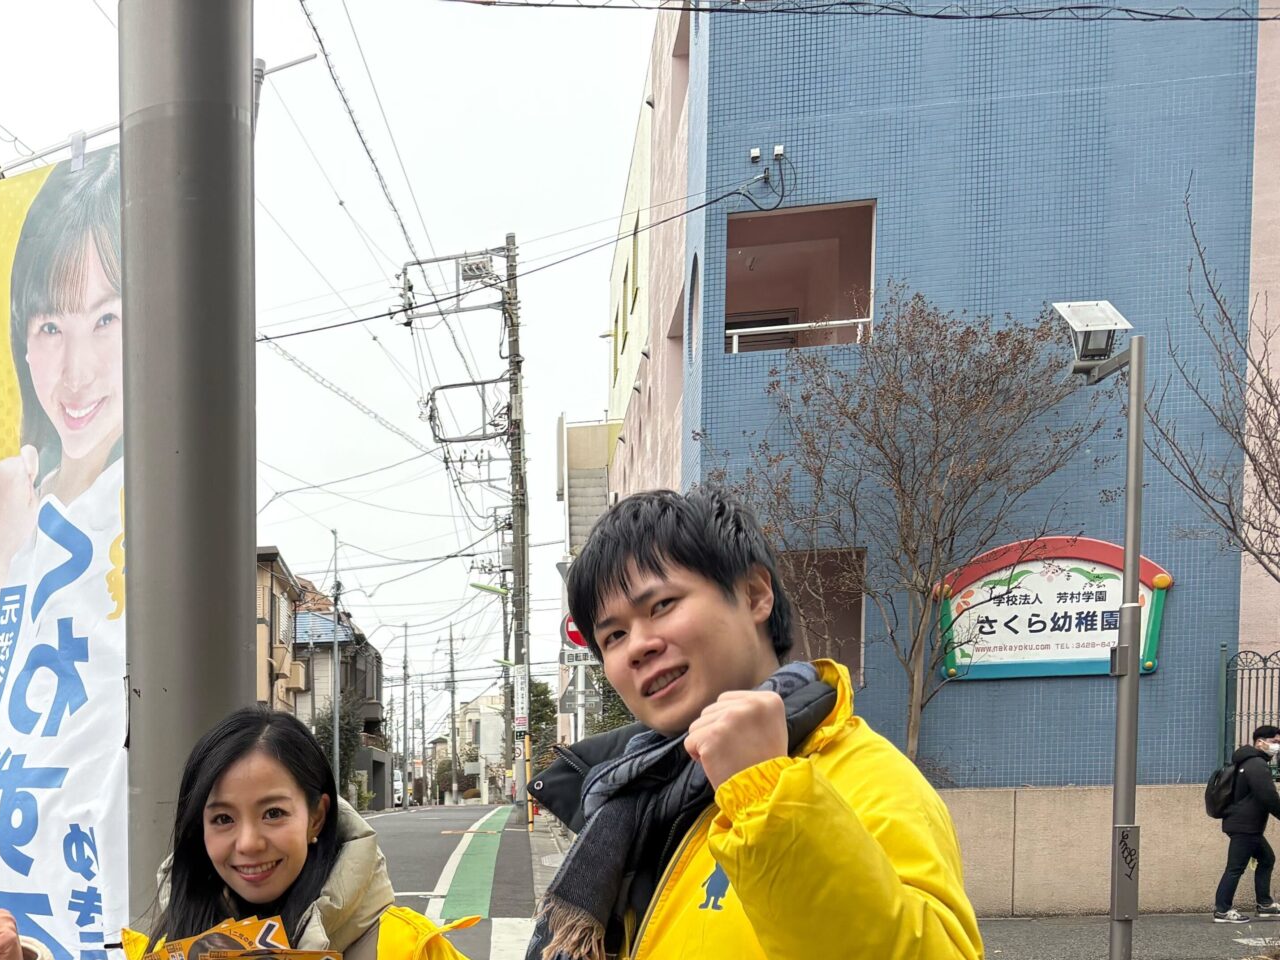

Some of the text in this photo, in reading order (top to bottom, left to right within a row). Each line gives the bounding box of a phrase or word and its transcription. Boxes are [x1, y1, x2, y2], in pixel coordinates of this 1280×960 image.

[993, 591, 1107, 606] 学校法人 芳村学園
[978, 610, 1120, 635] さくら幼稚園
[1056, 641, 1116, 650] TEL:3428-647
